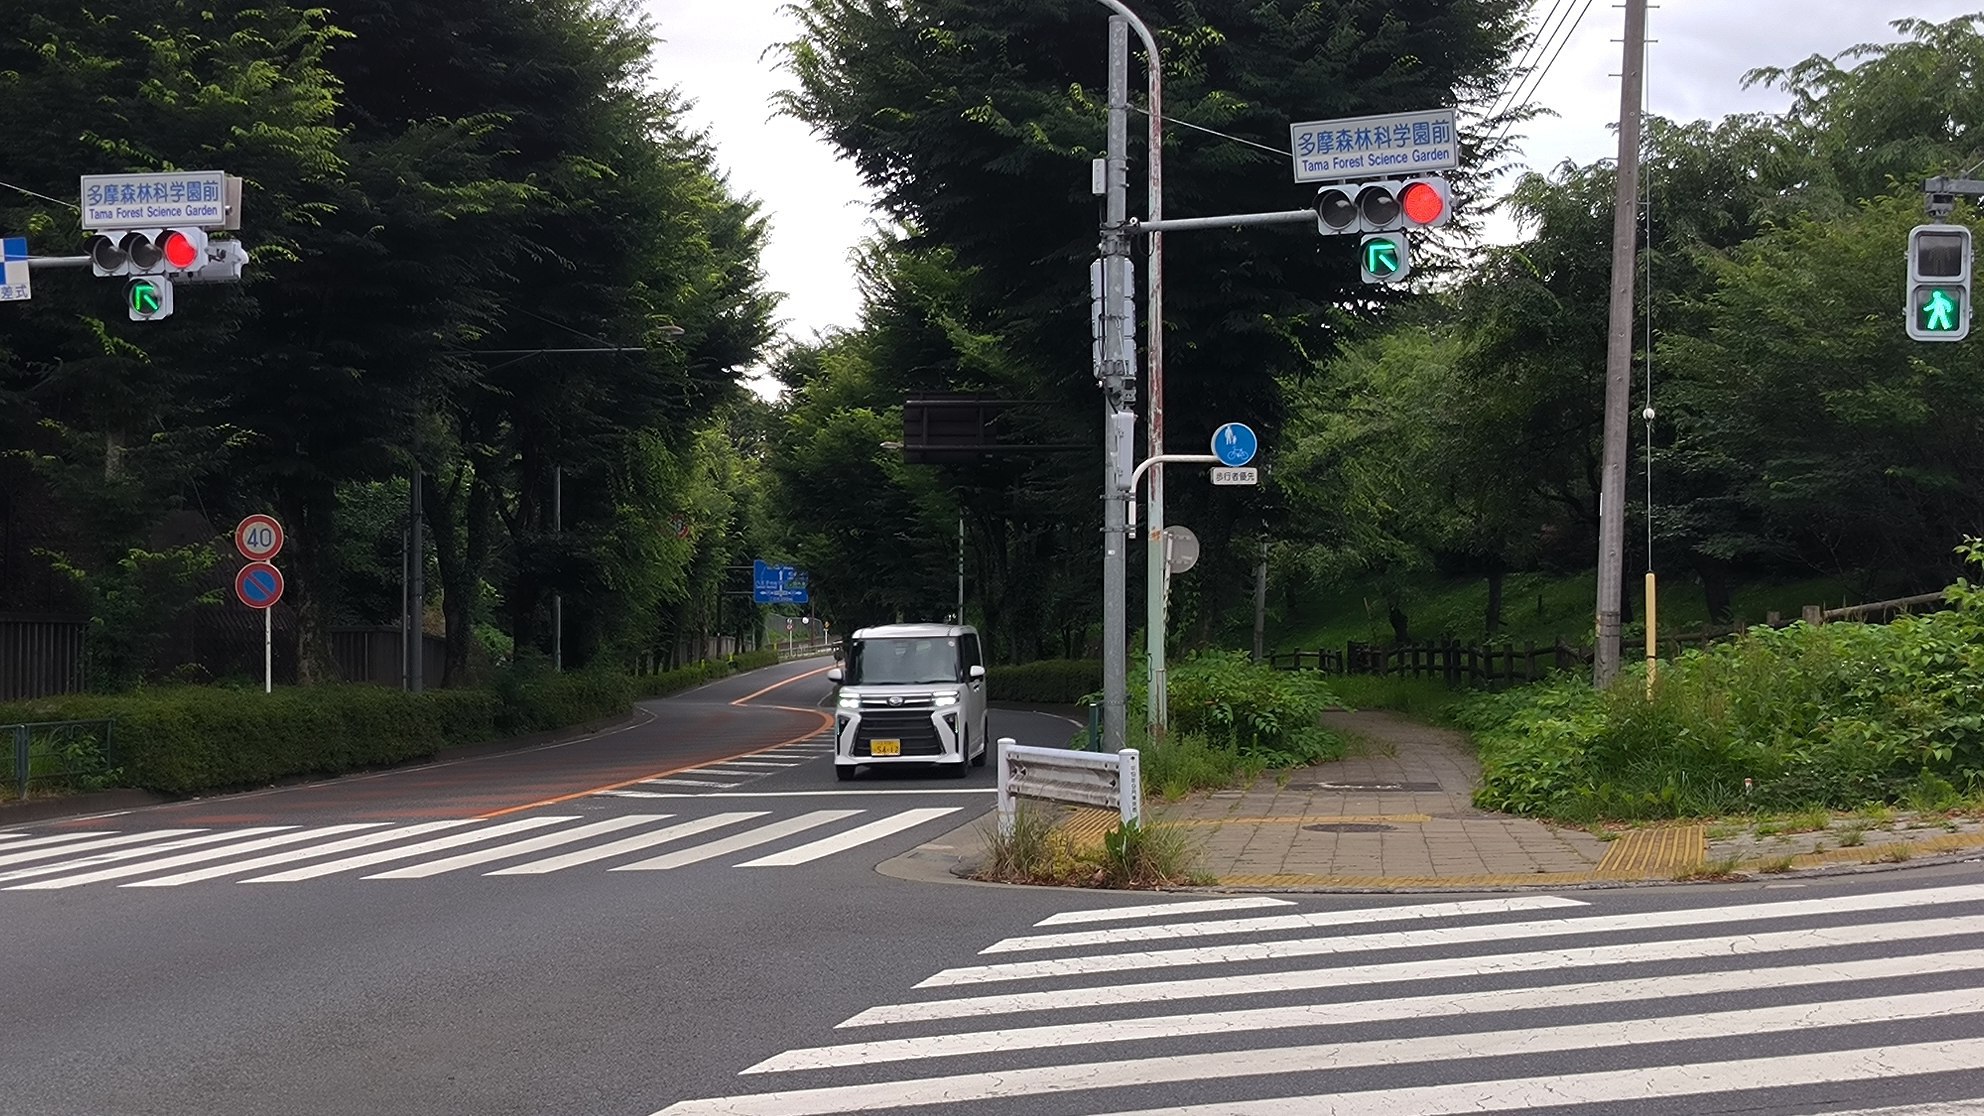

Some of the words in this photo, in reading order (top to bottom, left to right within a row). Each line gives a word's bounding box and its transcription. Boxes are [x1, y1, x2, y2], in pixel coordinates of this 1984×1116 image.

[1297, 120, 1450, 157] 多摩森林科学園前
[1302, 159, 1329, 172] Tama
[1333, 155, 1364, 169] Forest
[1368, 151, 1408, 166] Science
[1412, 148, 1449, 163] Garden
[87, 180, 219, 207] 多摩森林科学園前
[89, 208, 113, 219] Tama
[116, 206, 143, 218] Forest
[147, 204, 182, 217] Science
[185, 203, 218, 217] Garden
[1216, 471, 1255, 482] 歩行者優先
[247, 527, 272, 548] 40
